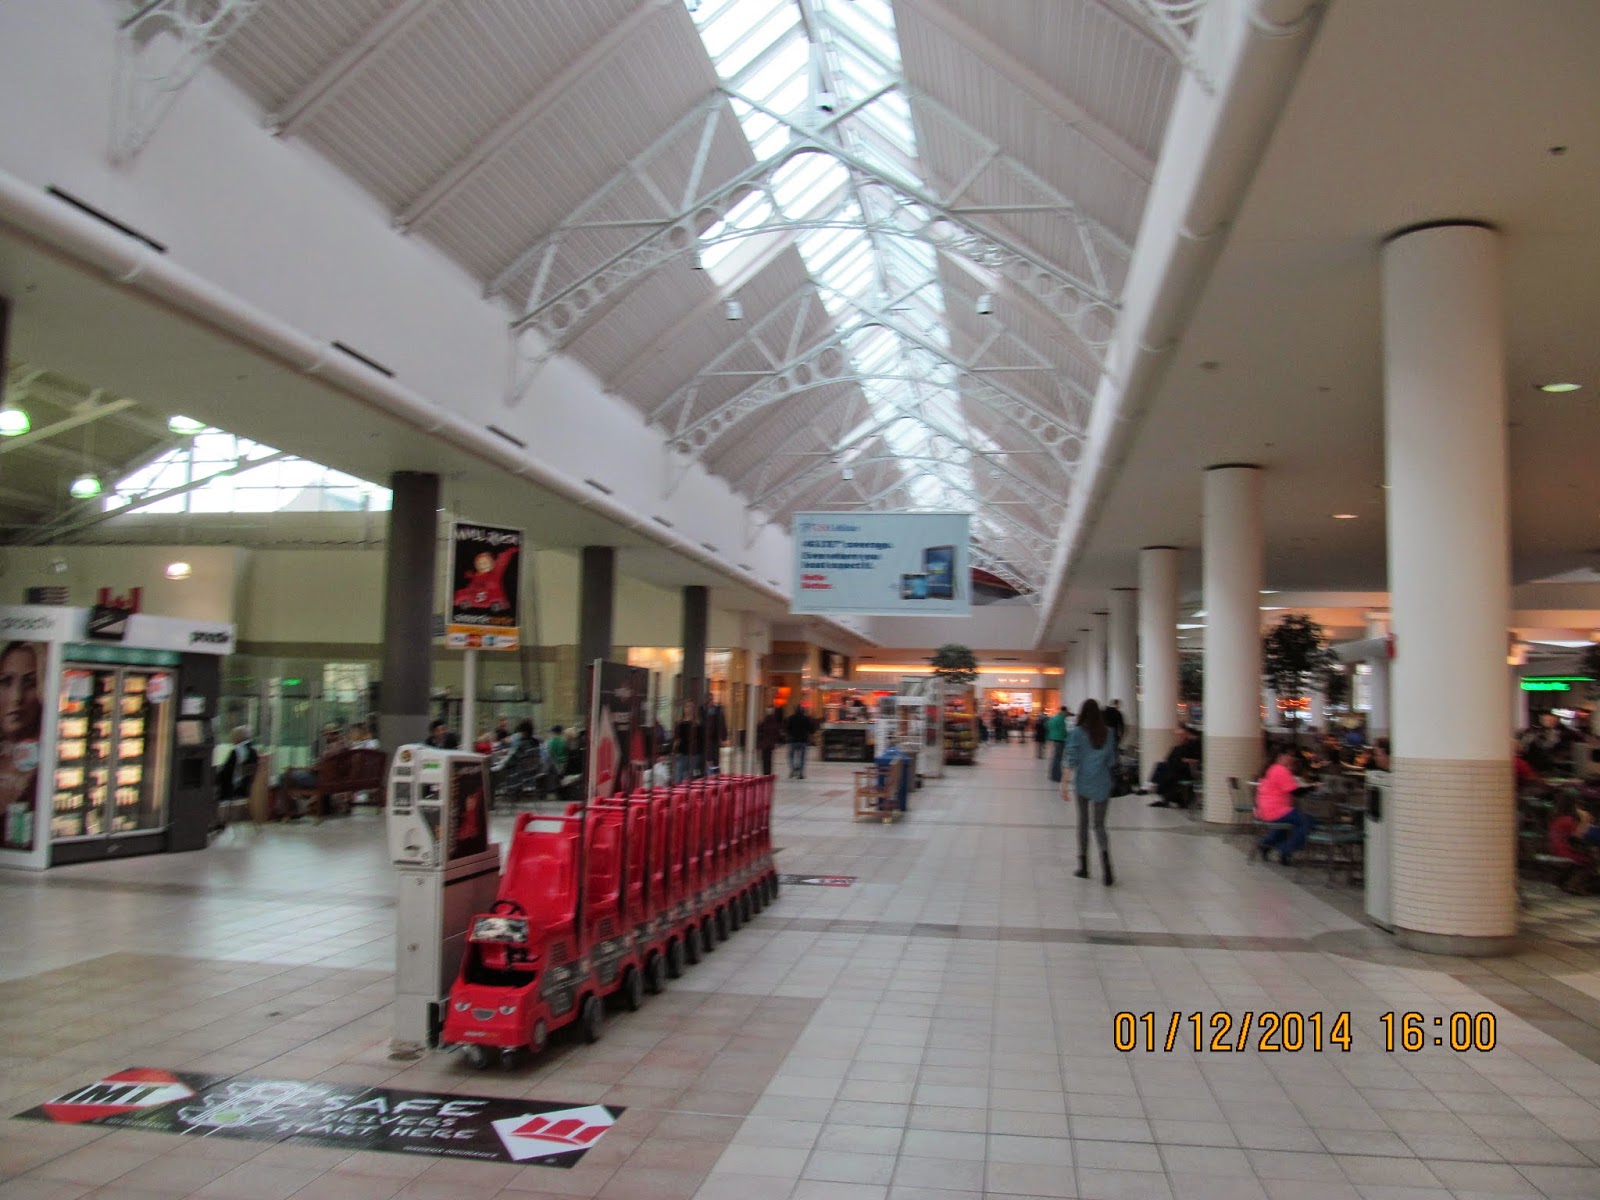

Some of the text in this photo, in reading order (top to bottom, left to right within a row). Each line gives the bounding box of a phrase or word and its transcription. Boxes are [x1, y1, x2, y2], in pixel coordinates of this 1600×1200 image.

[319, 1095, 489, 1118] SAFE
[321, 1112, 459, 1128] DRIVERS
[276, 1121, 480, 1140] START HERE
